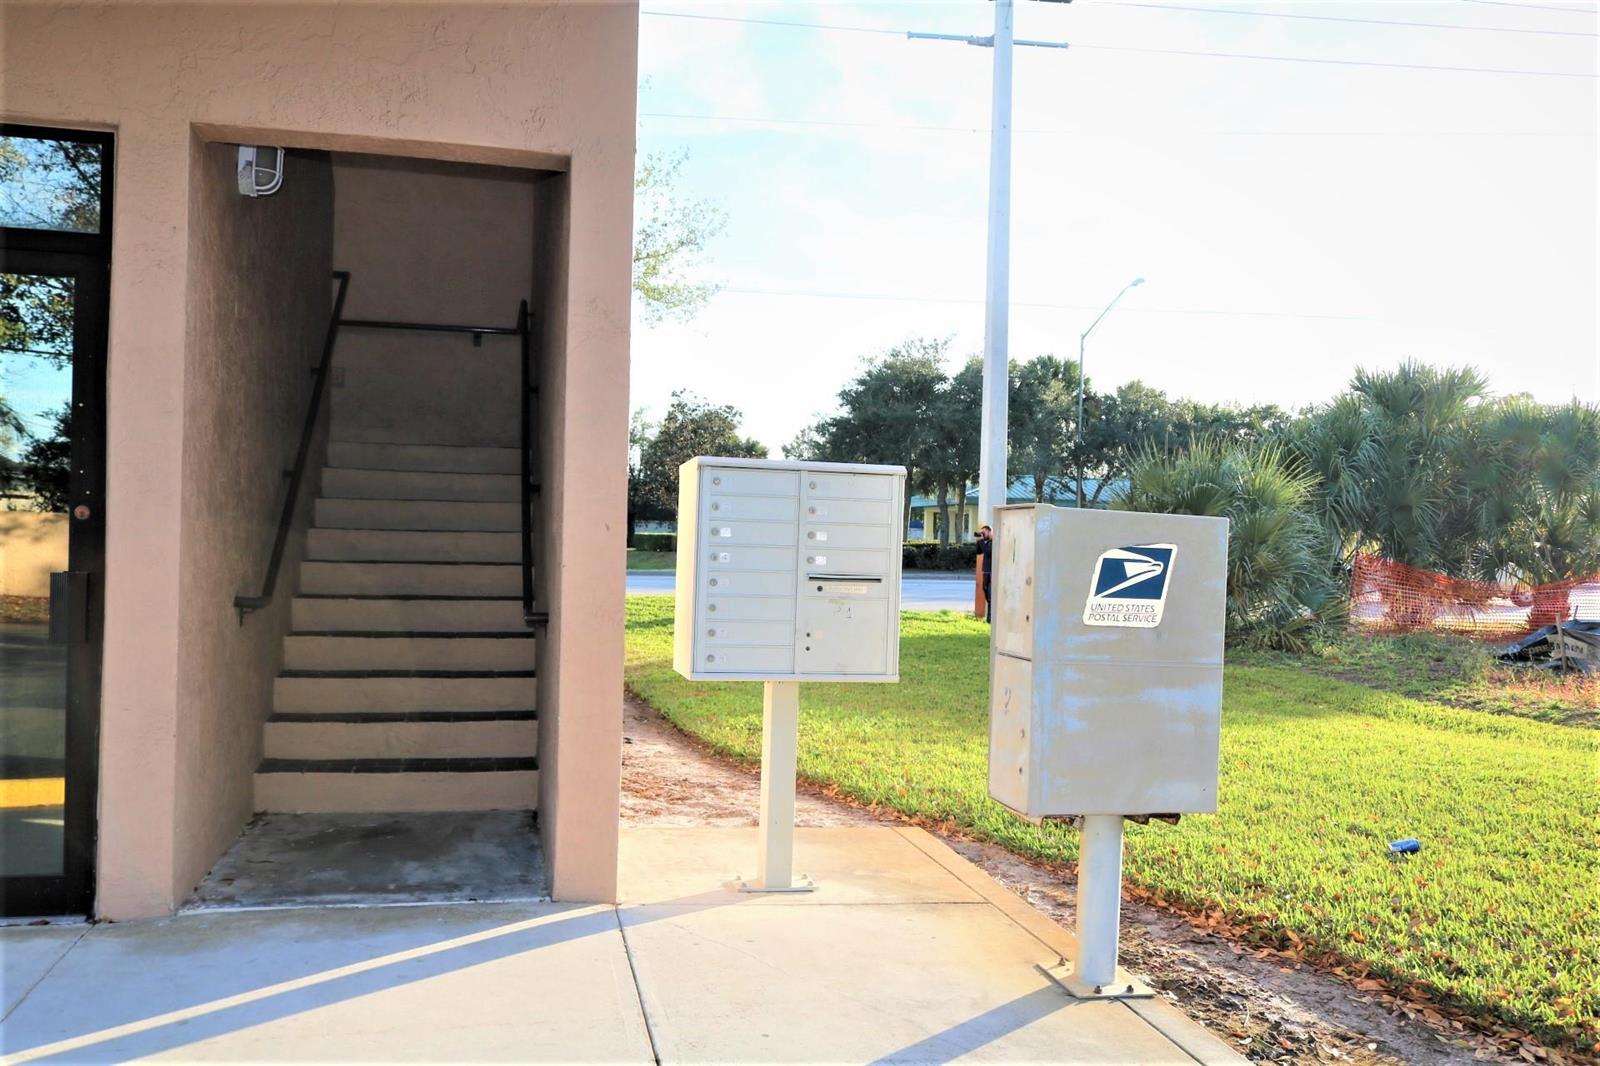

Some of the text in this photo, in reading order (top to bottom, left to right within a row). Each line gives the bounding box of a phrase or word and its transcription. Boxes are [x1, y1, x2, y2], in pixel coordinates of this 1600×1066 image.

[1090, 603, 1155, 613] UNITED STATES
[1088, 613, 1158, 623] POSTAL SERVICE
